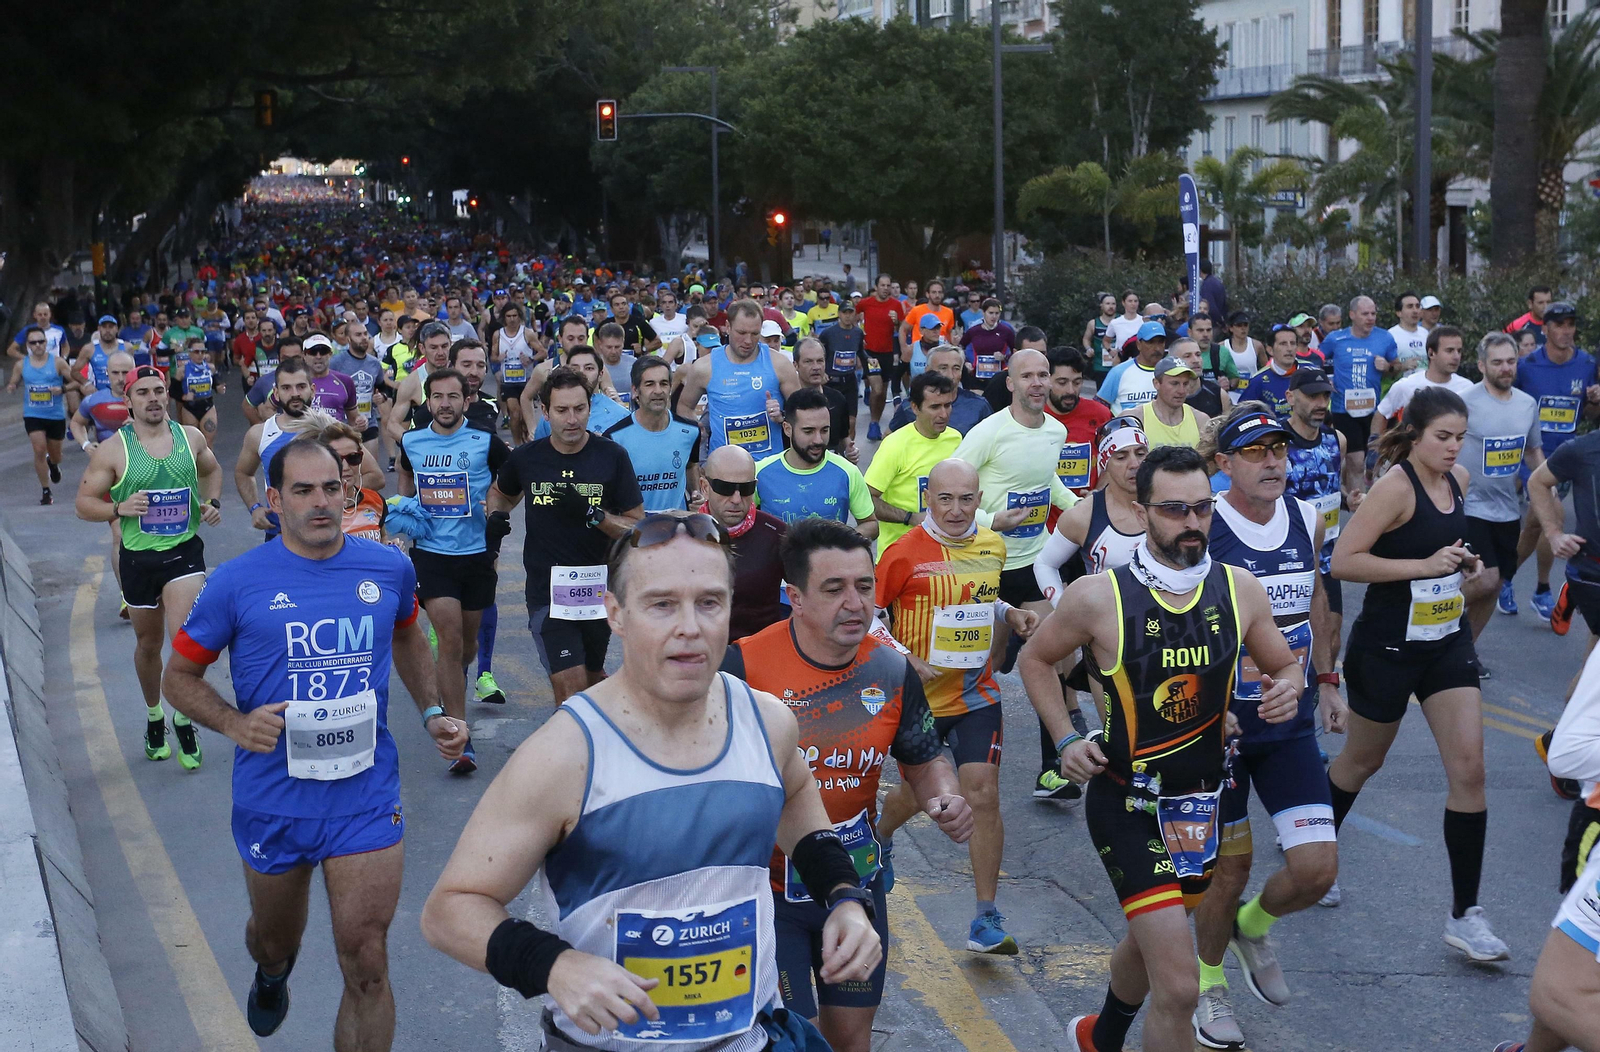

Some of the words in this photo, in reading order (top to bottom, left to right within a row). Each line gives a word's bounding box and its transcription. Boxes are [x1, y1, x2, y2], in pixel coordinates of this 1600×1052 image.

[739, 430, 757, 438] 1032
[422, 455, 452, 467] JULIO
[637, 473, 659, 481] CLUB
[531, 482, 603, 496] UNER
[640, 481, 678, 491] ORREDOR
[433, 490, 454, 499] 1804
[824, 496, 837, 506] edp
[156, 508, 178, 517] 3173
[1029, 509, 1038, 517] 83
[570, 588, 592, 597] 6458
[1432, 602, 1454, 615] 5644
[286, 615, 374, 656] RCM
[954, 630, 979, 641] 5708
[322, 655, 372, 666] MEDITERRANEO
[1162, 646, 1209, 668] ROVI
[288, 668, 371, 700] 1873
[332, 703, 366, 717] ZURICH
[316, 729, 354, 747] 8058
[824, 748, 852, 768] del
[625, 930, 642, 938] 42K
[679, 920, 730, 940] ZURICH
[664, 960, 722, 986] 1557
